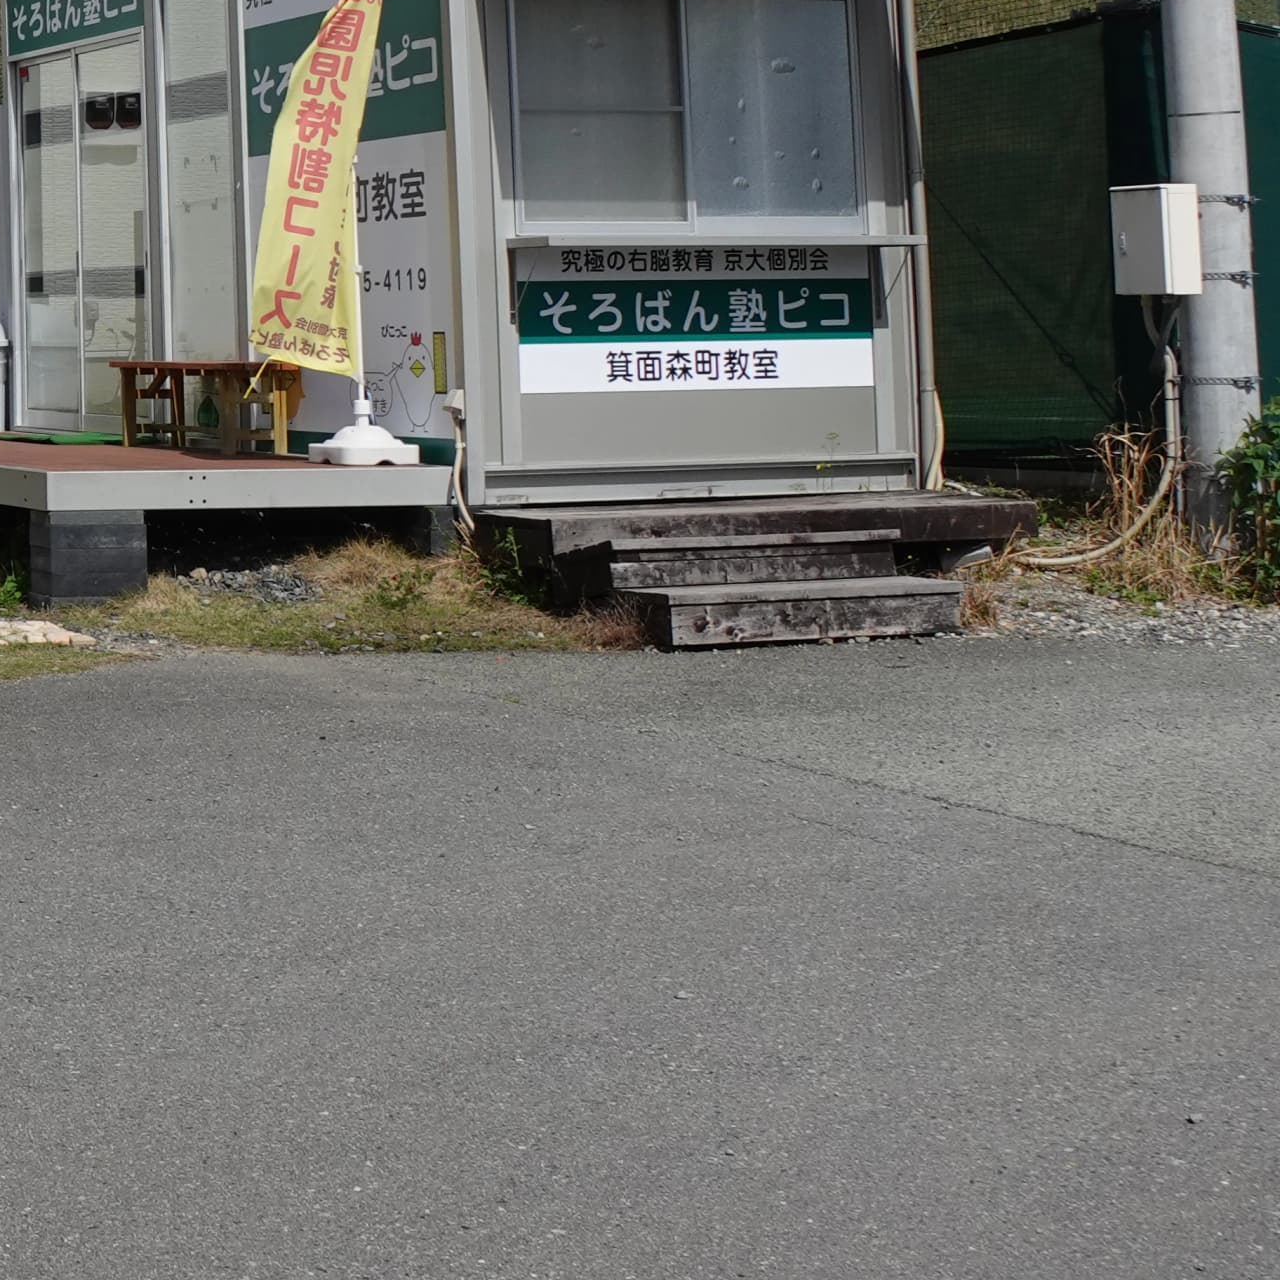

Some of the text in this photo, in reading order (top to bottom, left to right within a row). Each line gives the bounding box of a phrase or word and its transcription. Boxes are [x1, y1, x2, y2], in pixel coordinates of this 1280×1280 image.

[561, 248, 829, 273] 究極の右脳教育 京大個別会
[539, 288, 851, 334] そろばん塾ピコ
[606, 348, 779, 383] 箕面森町教室
